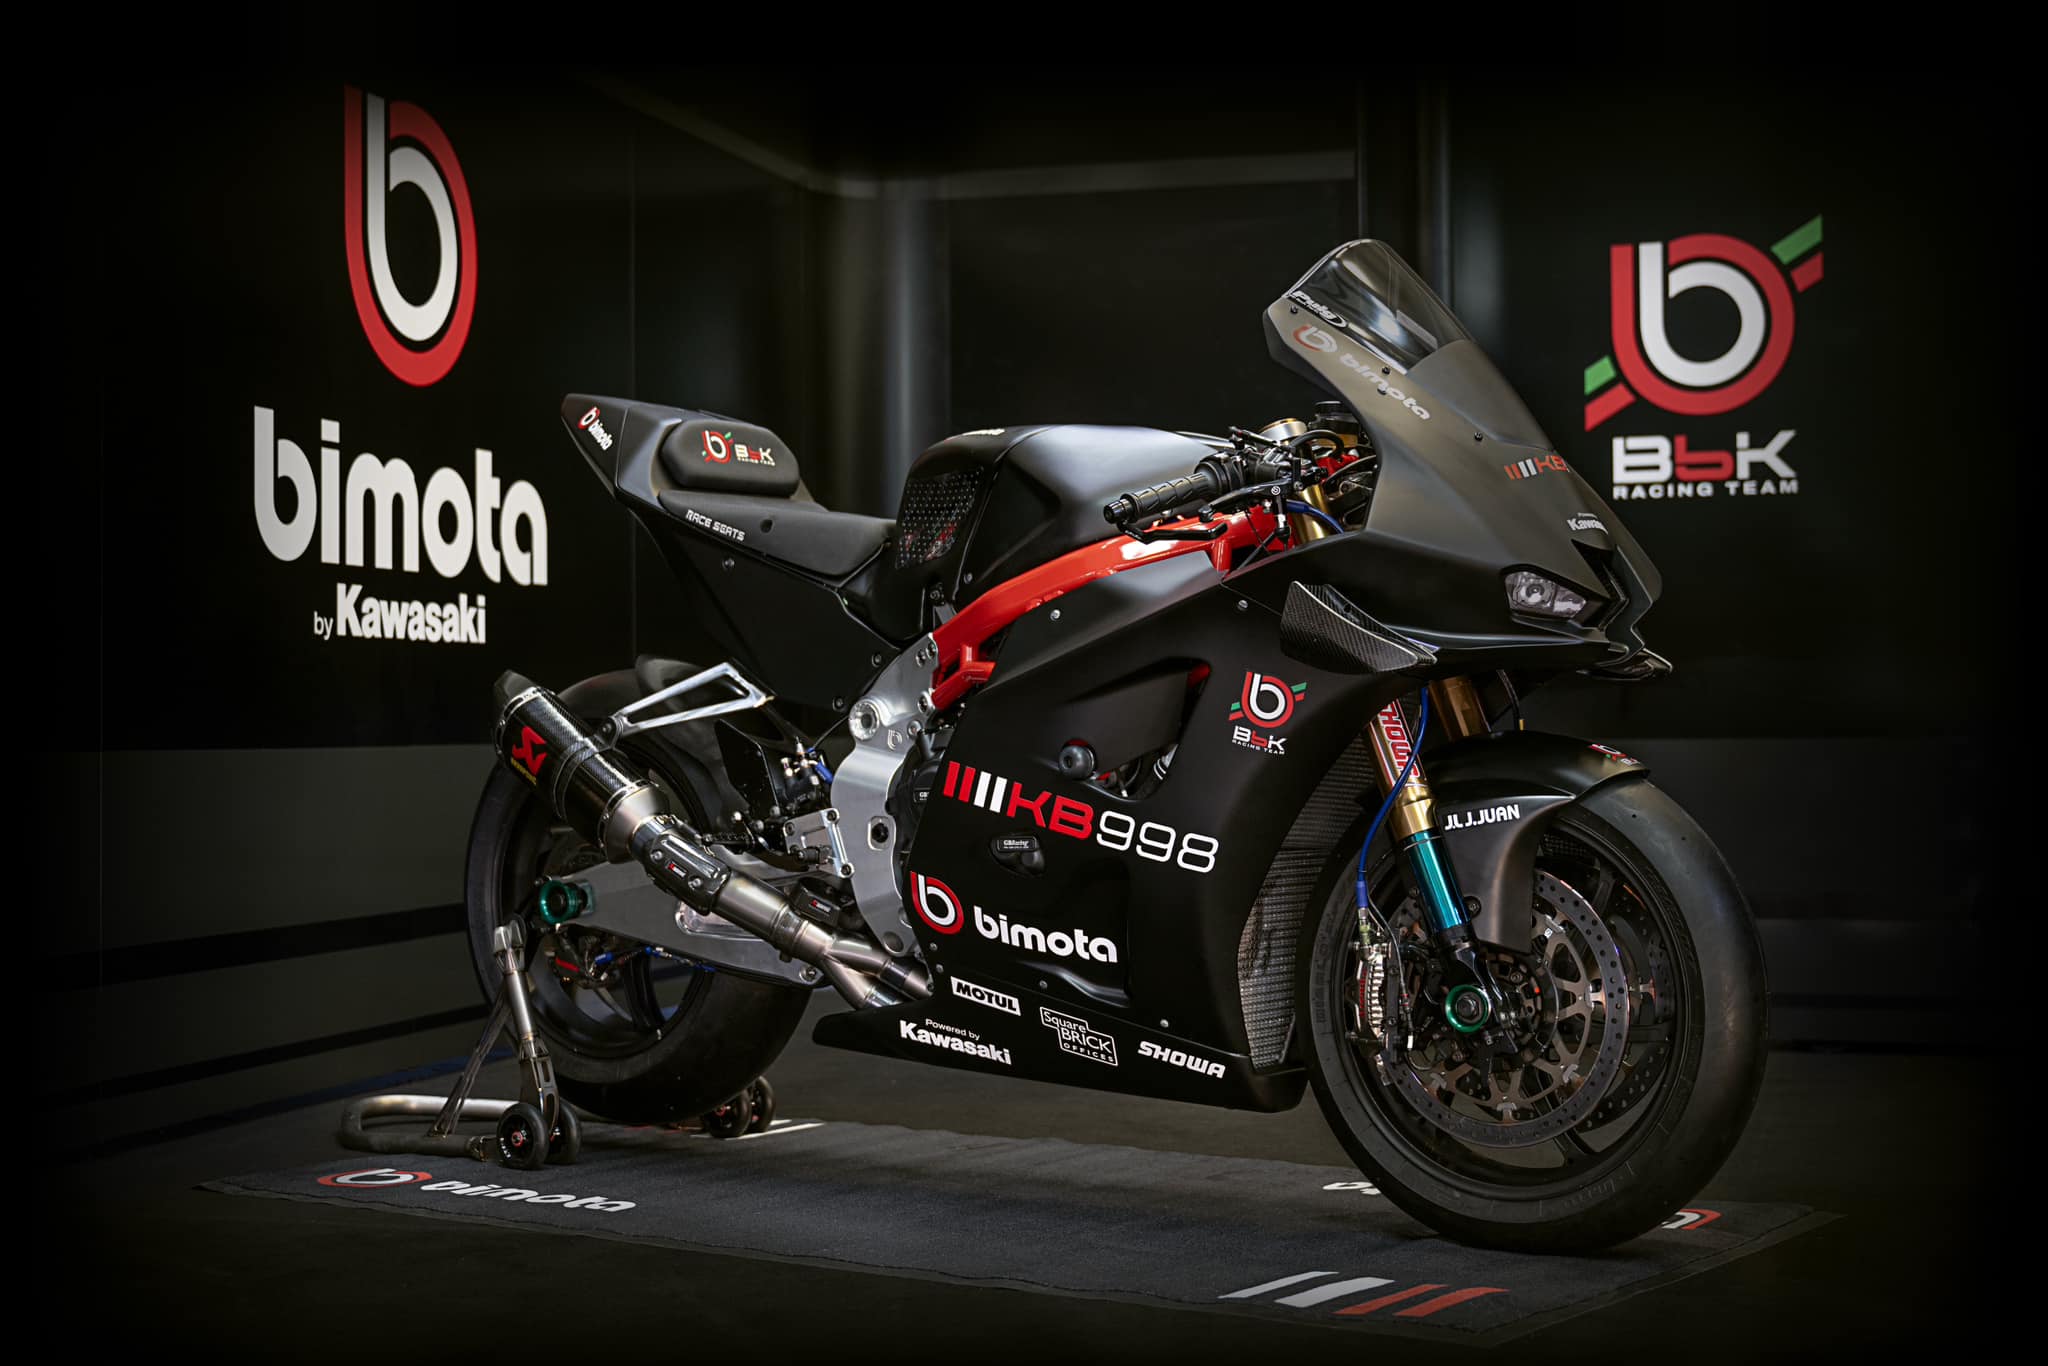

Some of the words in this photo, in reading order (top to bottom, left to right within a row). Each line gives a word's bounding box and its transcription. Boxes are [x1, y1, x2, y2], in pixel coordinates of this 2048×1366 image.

[1533, 455, 1569, 473] KB
[254, 405, 548, 586] bimota
[1612, 482, 1715, 500] RACING
[1724, 479, 1799, 496] TEAM
[685, 509, 712, 528] RACE
[712, 521, 746, 541] SEATS
[313, 610, 334, 641] by
[336, 582, 487, 644] Kawasaki
[973, 905, 1119, 964] bimota
[956, 981, 1018, 1012] MOTUL
[925, 1018, 967, 1037] Powered
[968, 1030, 981, 1041] by
[1044, 1011, 1087, 1033] Square
[899, 1019, 1012, 1065] Kawasaki
[1061, 1027, 1113, 1054] BRICK
[1063, 1042, 1114, 1063] OFFICES
[1137, 1040, 1227, 1079] SHOWA
